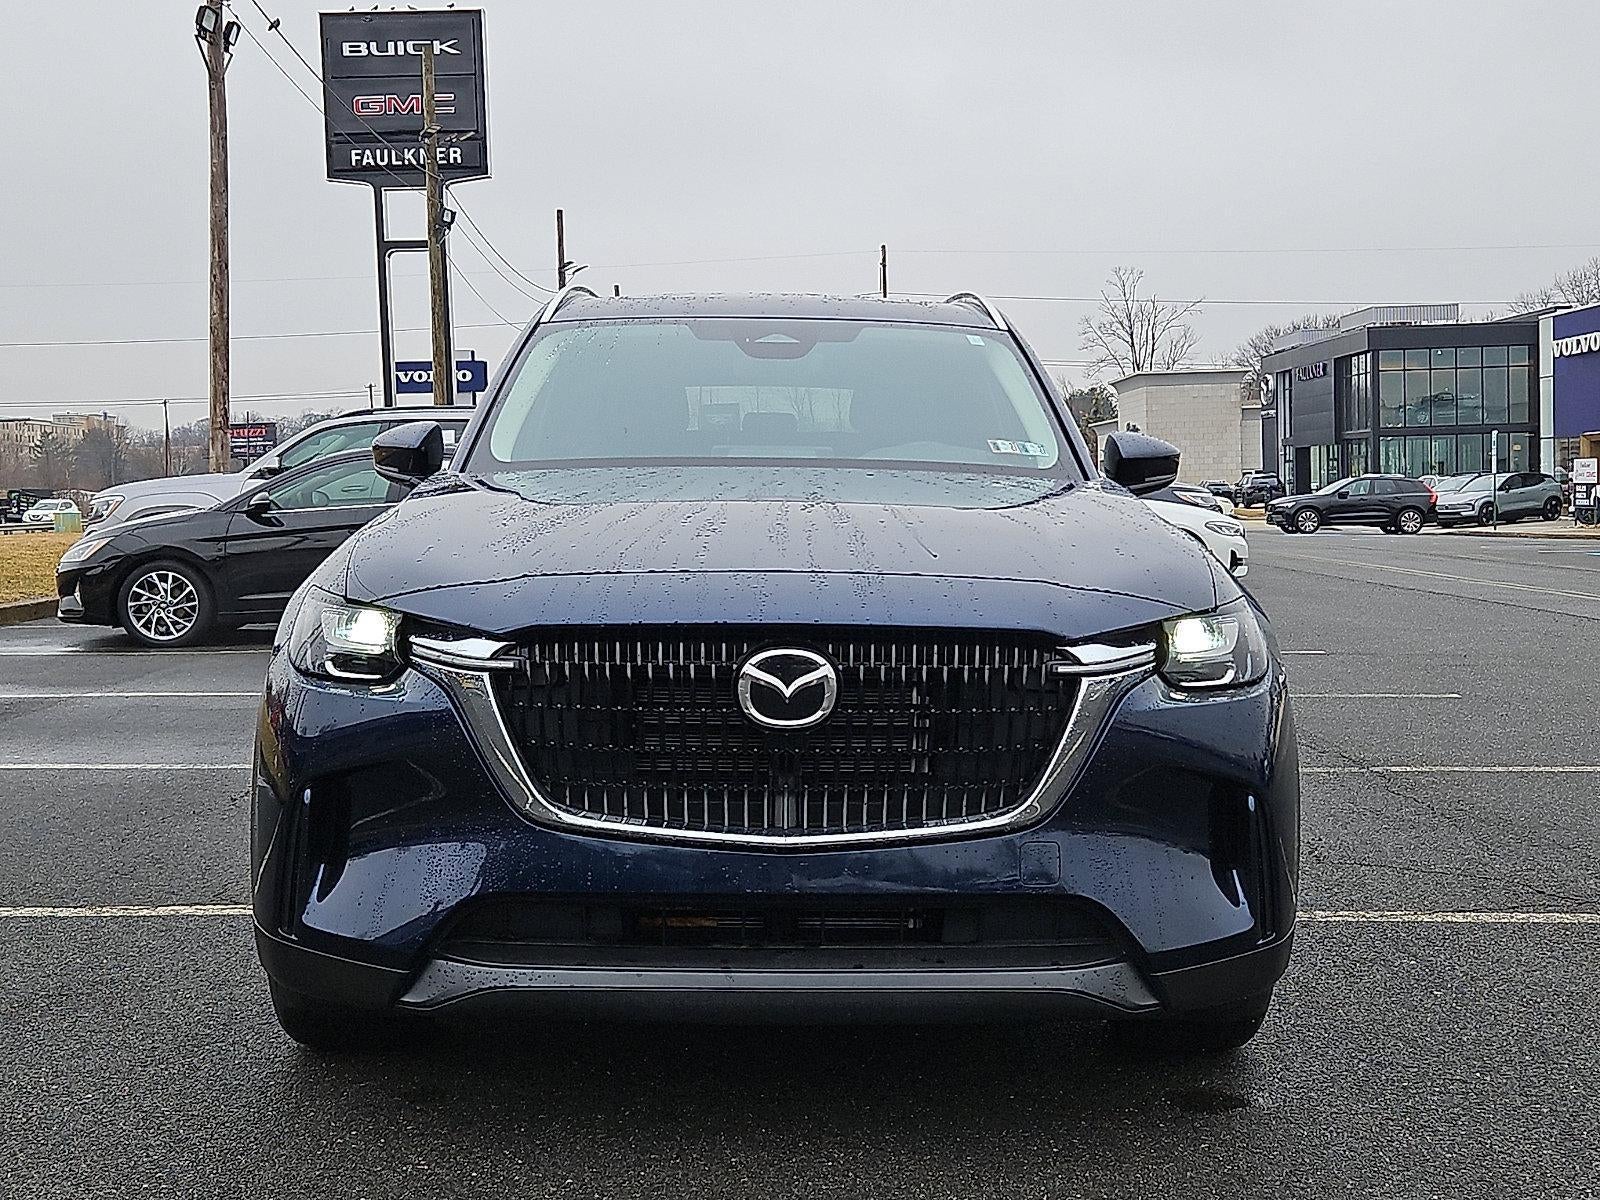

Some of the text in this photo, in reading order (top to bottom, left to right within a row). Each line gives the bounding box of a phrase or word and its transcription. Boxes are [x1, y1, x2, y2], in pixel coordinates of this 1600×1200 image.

[341, 39, 462, 57] BUICK
[1552, 331, 1600, 358] VOLVO
[395, 369, 473, 383] VOO
